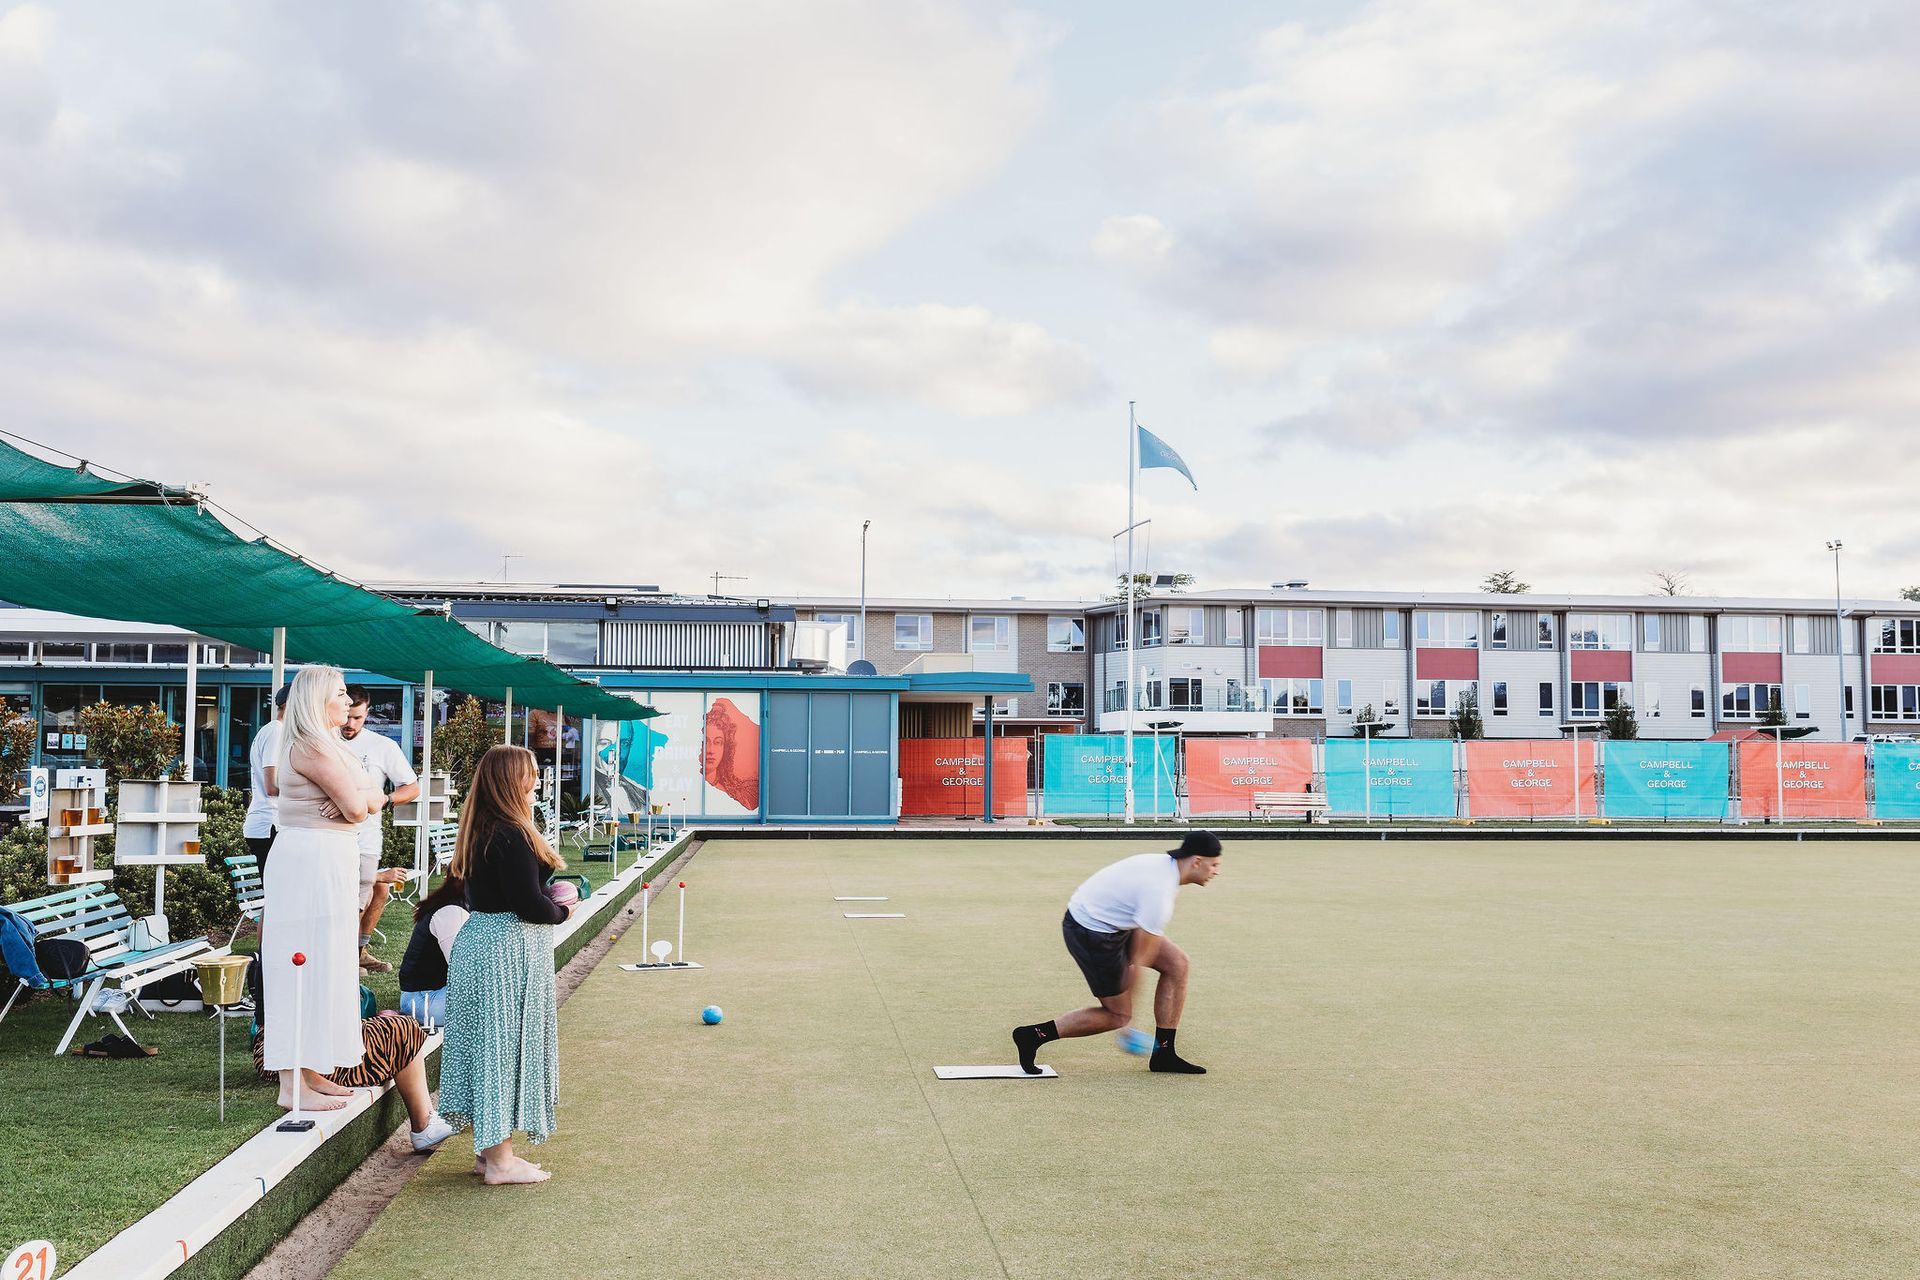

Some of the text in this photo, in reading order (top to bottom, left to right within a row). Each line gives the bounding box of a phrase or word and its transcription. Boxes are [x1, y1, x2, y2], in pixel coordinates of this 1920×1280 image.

[935, 757, 984, 766] CAMPBEL
[1223, 757, 1279, 766] CAMPBELL
[1503, 759, 1559, 768] CAMPBELL
[1639, 760, 1694, 769] CAMPBELL
[959, 767, 967, 775] &
[1105, 765, 1113, 773] &
[1248, 766, 1256, 775] &
[1387, 768, 1396, 776] &
[1527, 769, 1536, 777] &
[1663, 770, 1671, 778] &
[1799, 770, 1808, 778] &
[942, 777, 984, 786] GEORGE
[1231, 776, 1273, 785] GEORGE
[1370, 777, 1413, 786] GEORGE
[1511, 778, 1553, 788] GEORGE
[1647, 779, 1688, 788] GEORGE
[1783, 780, 1825, 788] GEORGE
[15, 1247, 48, 1280] 21
